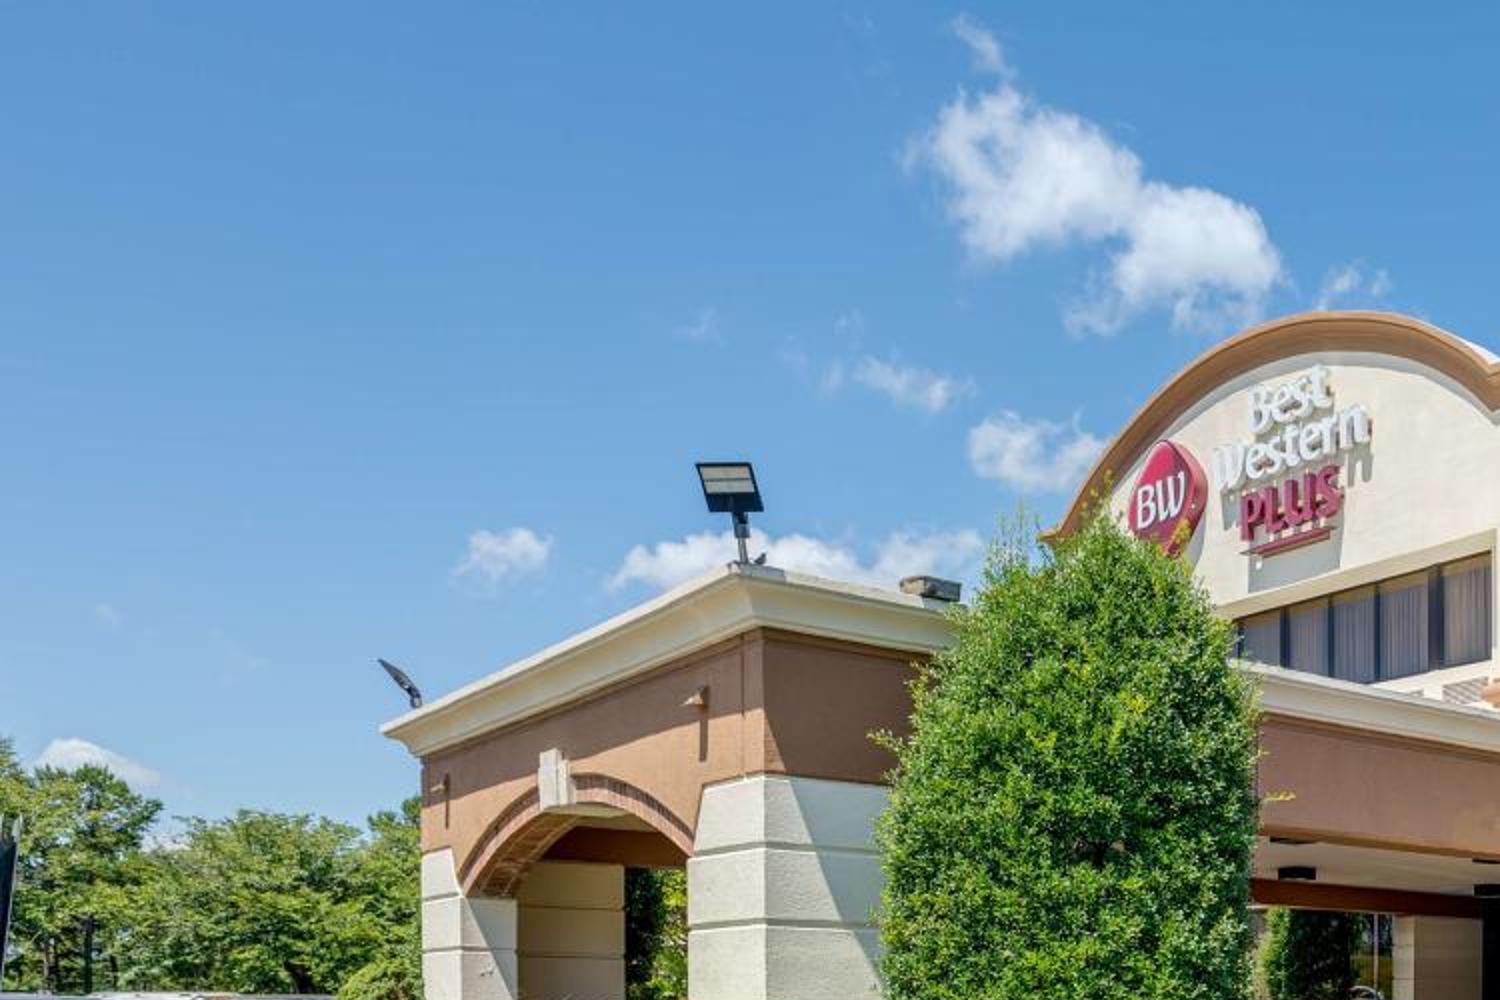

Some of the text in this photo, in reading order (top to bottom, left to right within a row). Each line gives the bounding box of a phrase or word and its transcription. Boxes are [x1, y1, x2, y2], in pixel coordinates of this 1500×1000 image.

[1250, 365, 1332, 435] Best
[1213, 404, 1371, 490] Western
[1136, 471, 1185, 529] BW
[1240, 464, 1344, 541] PLUS
